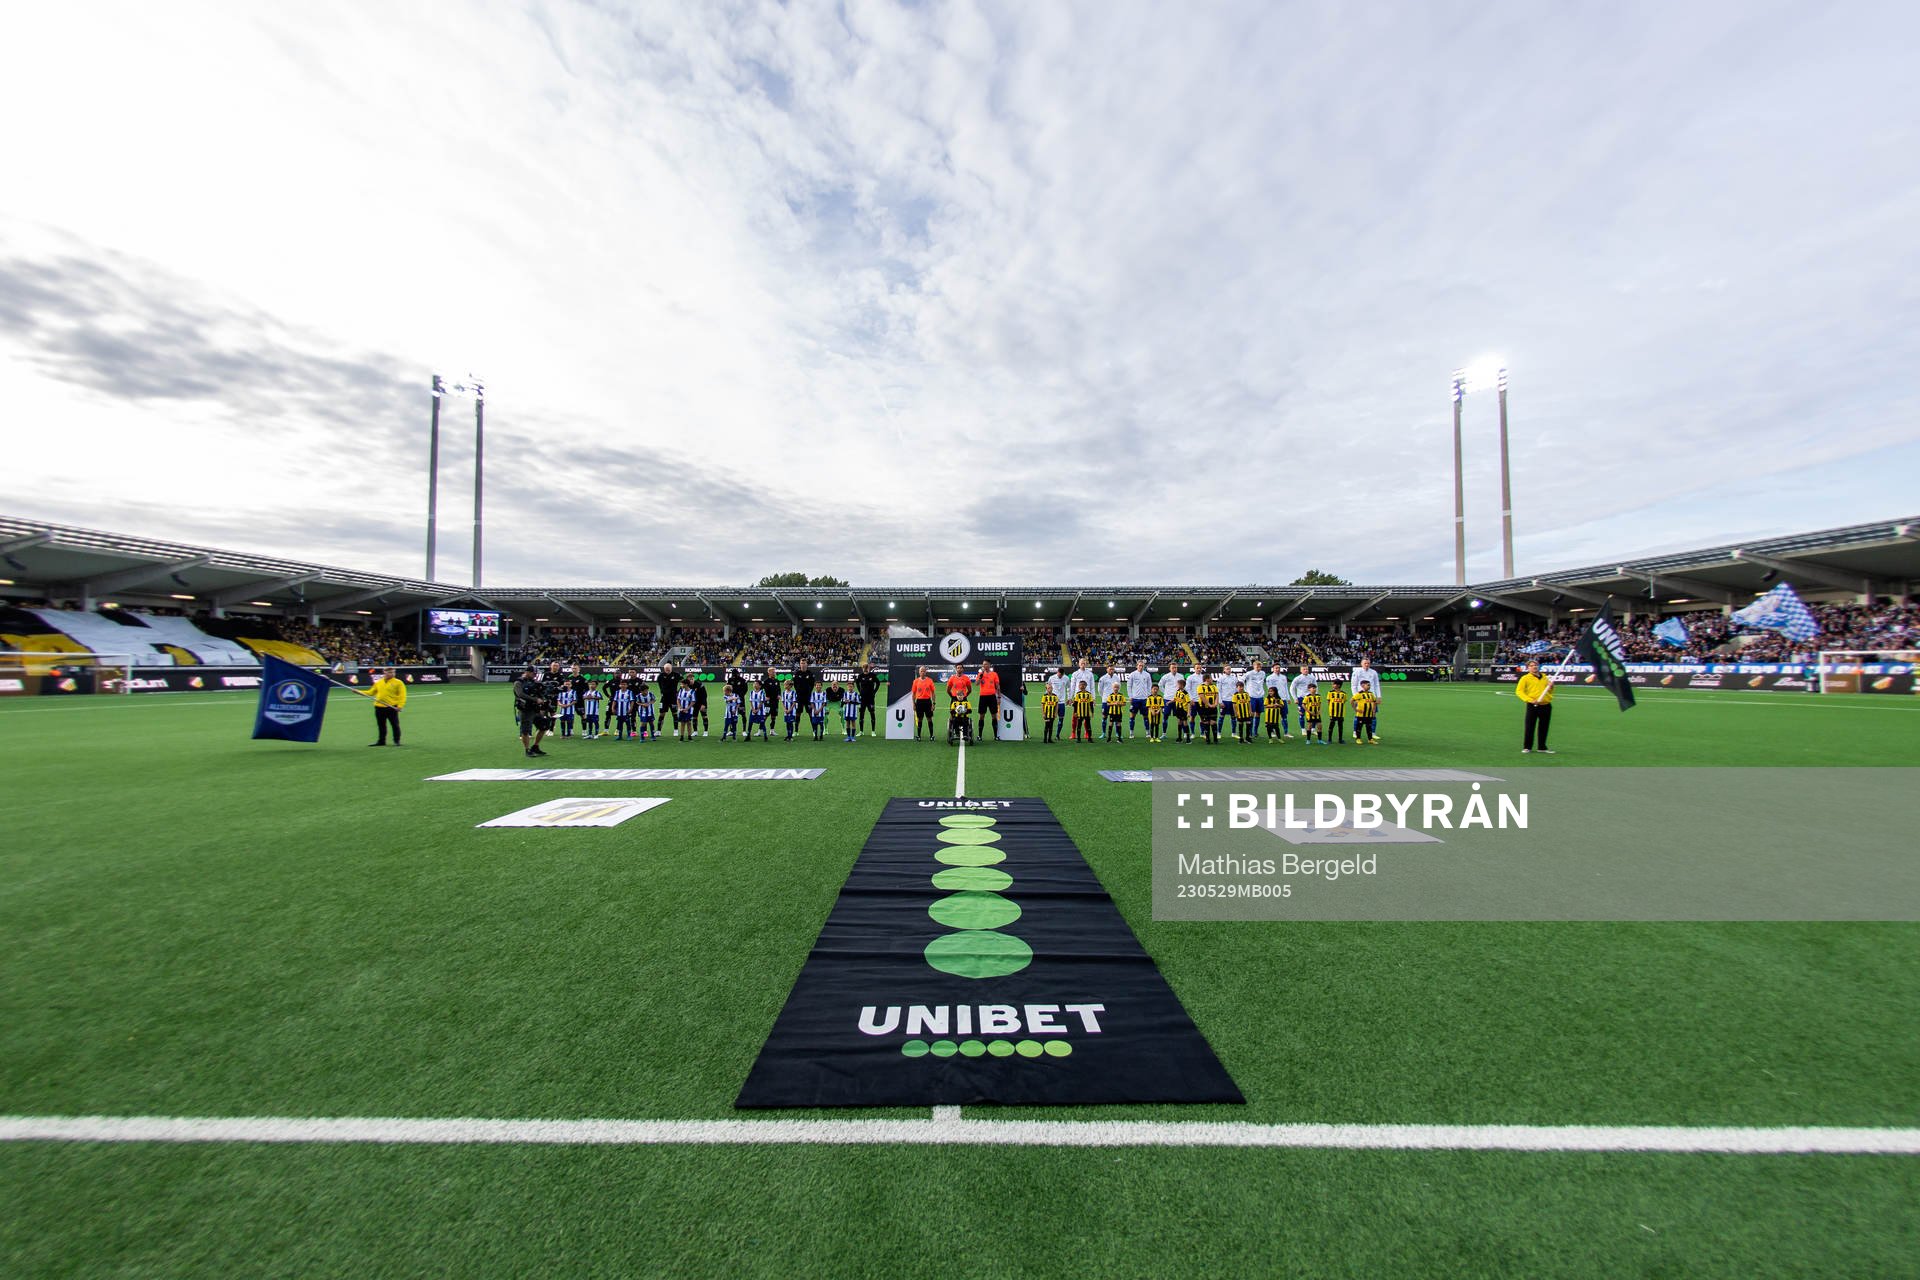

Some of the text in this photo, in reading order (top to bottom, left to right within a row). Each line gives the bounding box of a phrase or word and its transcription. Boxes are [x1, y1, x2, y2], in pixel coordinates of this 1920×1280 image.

[896, 643, 933, 652] UNIBET
[977, 641, 1015, 651] UNIBET
[896, 709, 906, 721] U
[1003, 709, 1014, 722] U
[858, 1004, 1105, 1036] UNIBET
